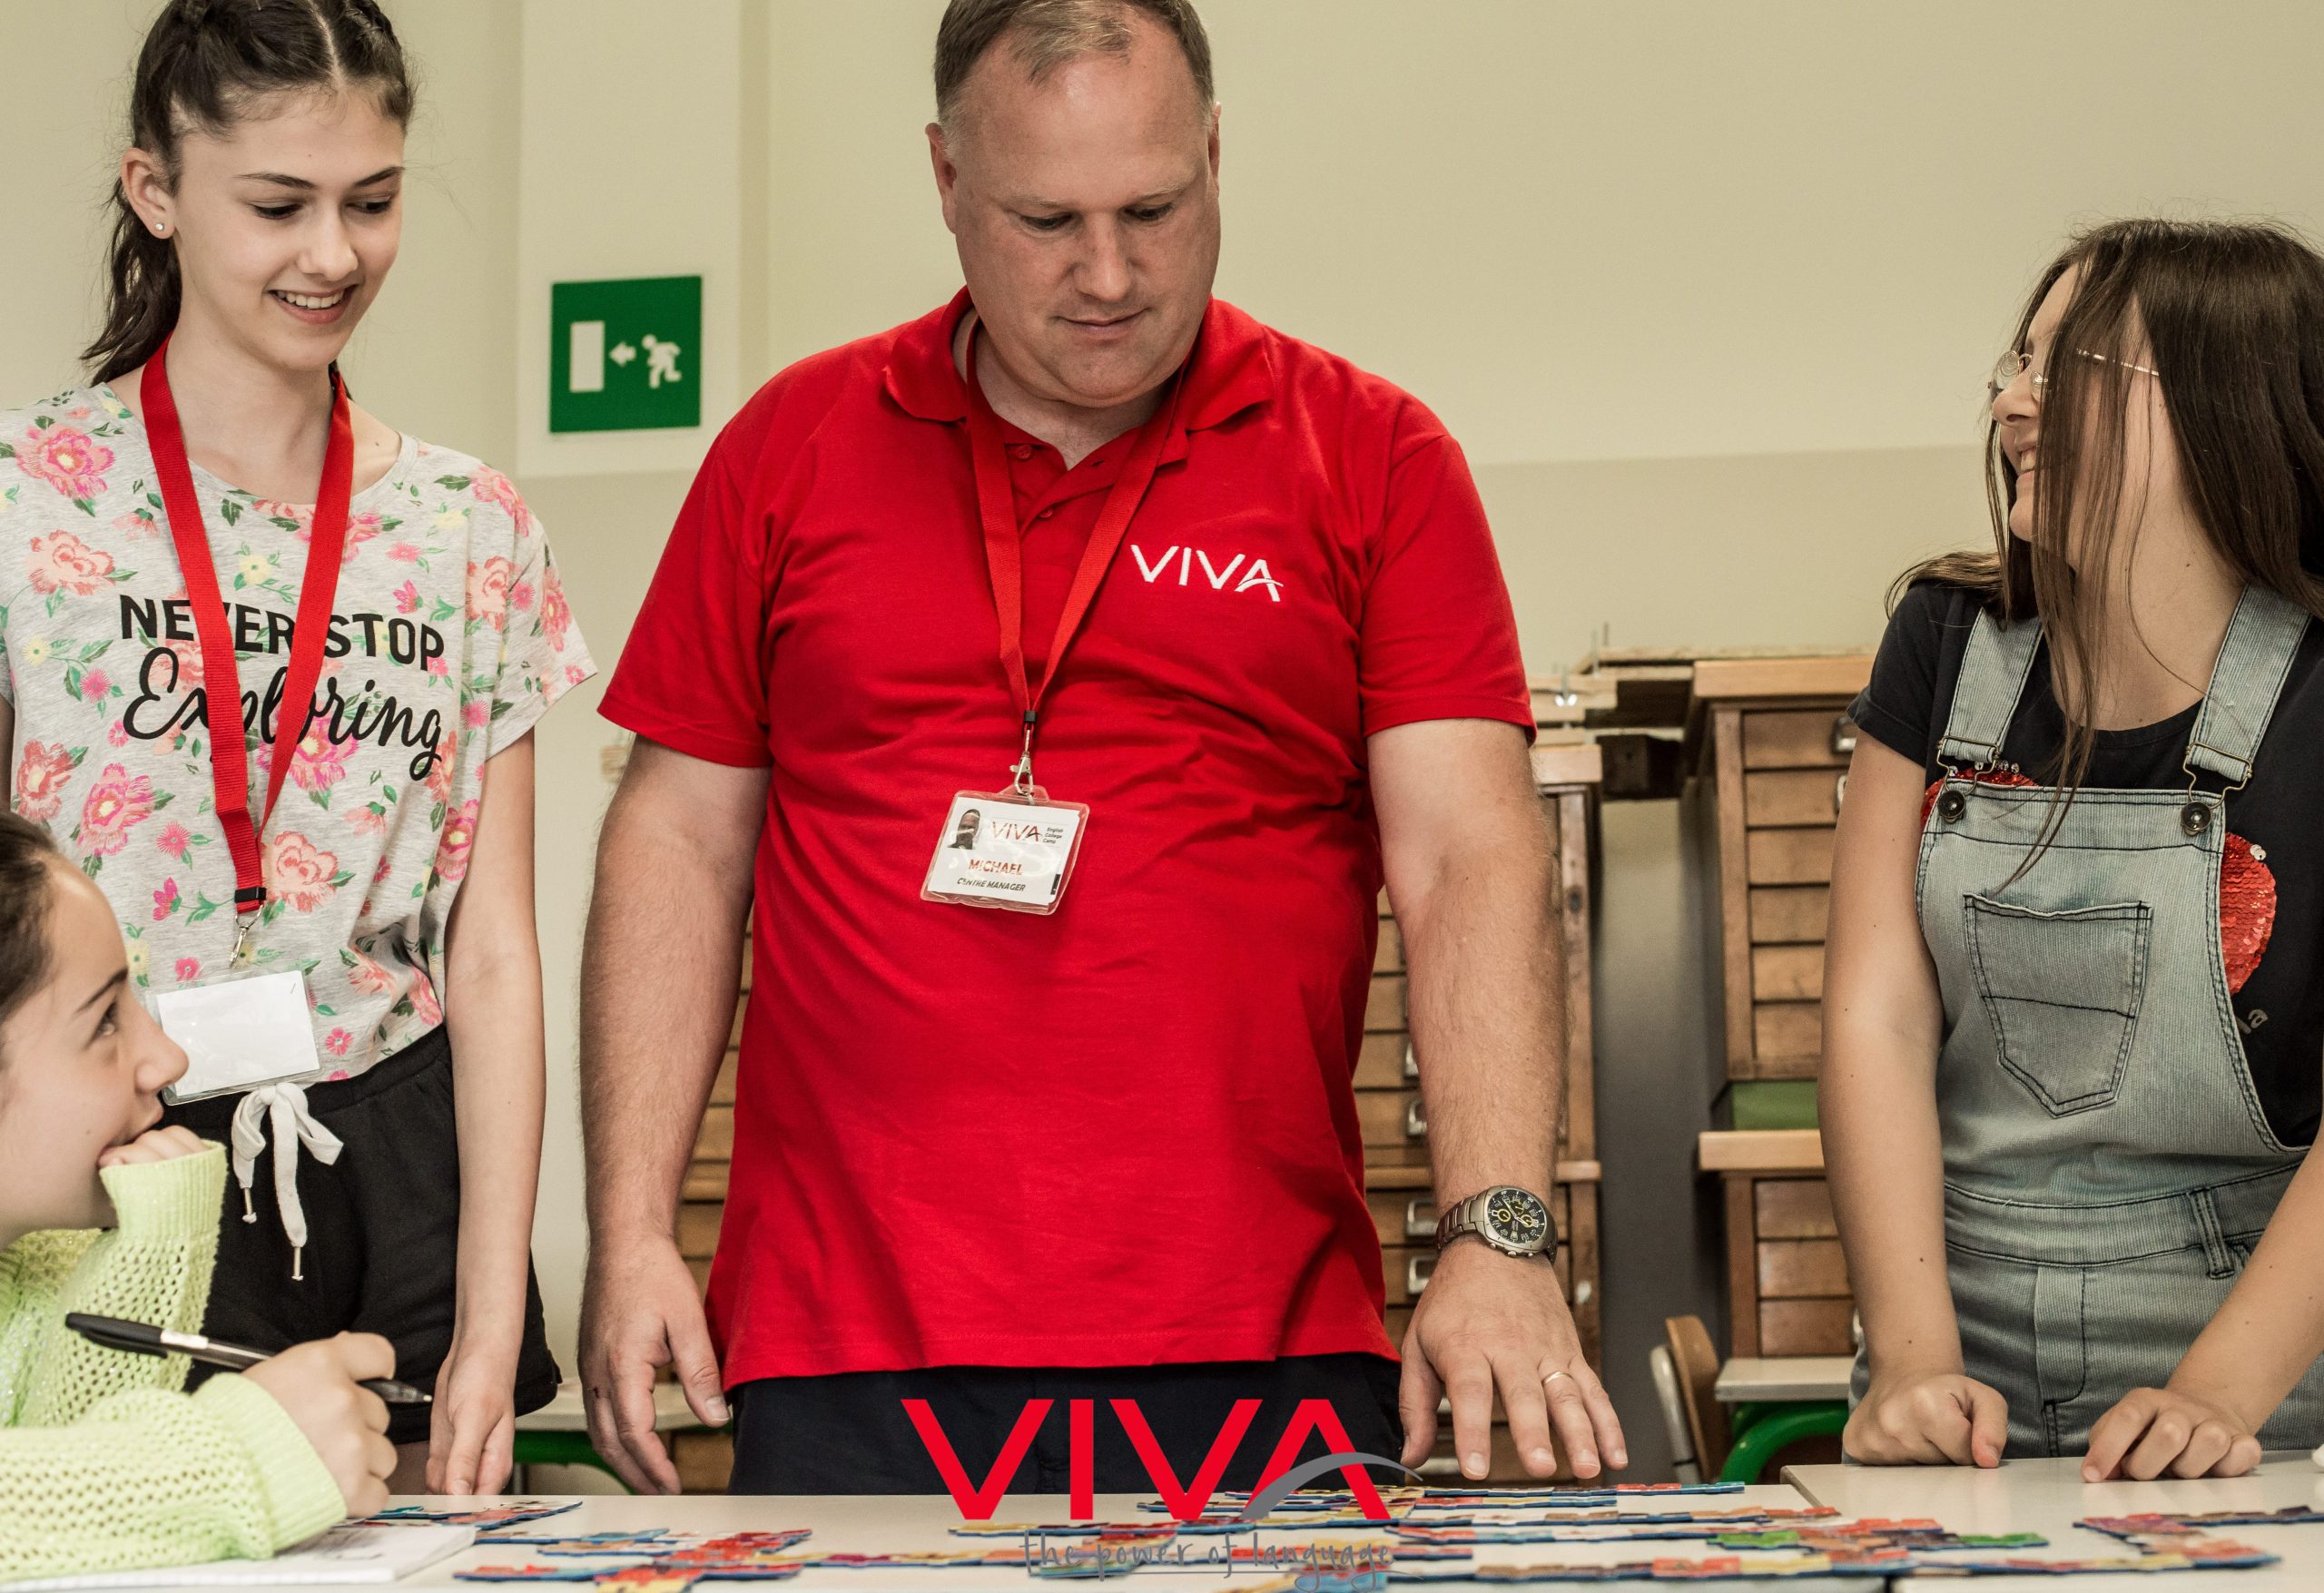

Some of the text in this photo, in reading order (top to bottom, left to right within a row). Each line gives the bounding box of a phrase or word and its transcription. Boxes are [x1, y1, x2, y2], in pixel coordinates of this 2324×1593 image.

[1130, 544, 1284, 603] VIVA
[120, 595, 445, 672] NEER STOP
[992, 821, 1043, 842] VIVA
[969, 859, 1023, 875] MICHAEL
[986, 880, 1026, 891] MANAGER
